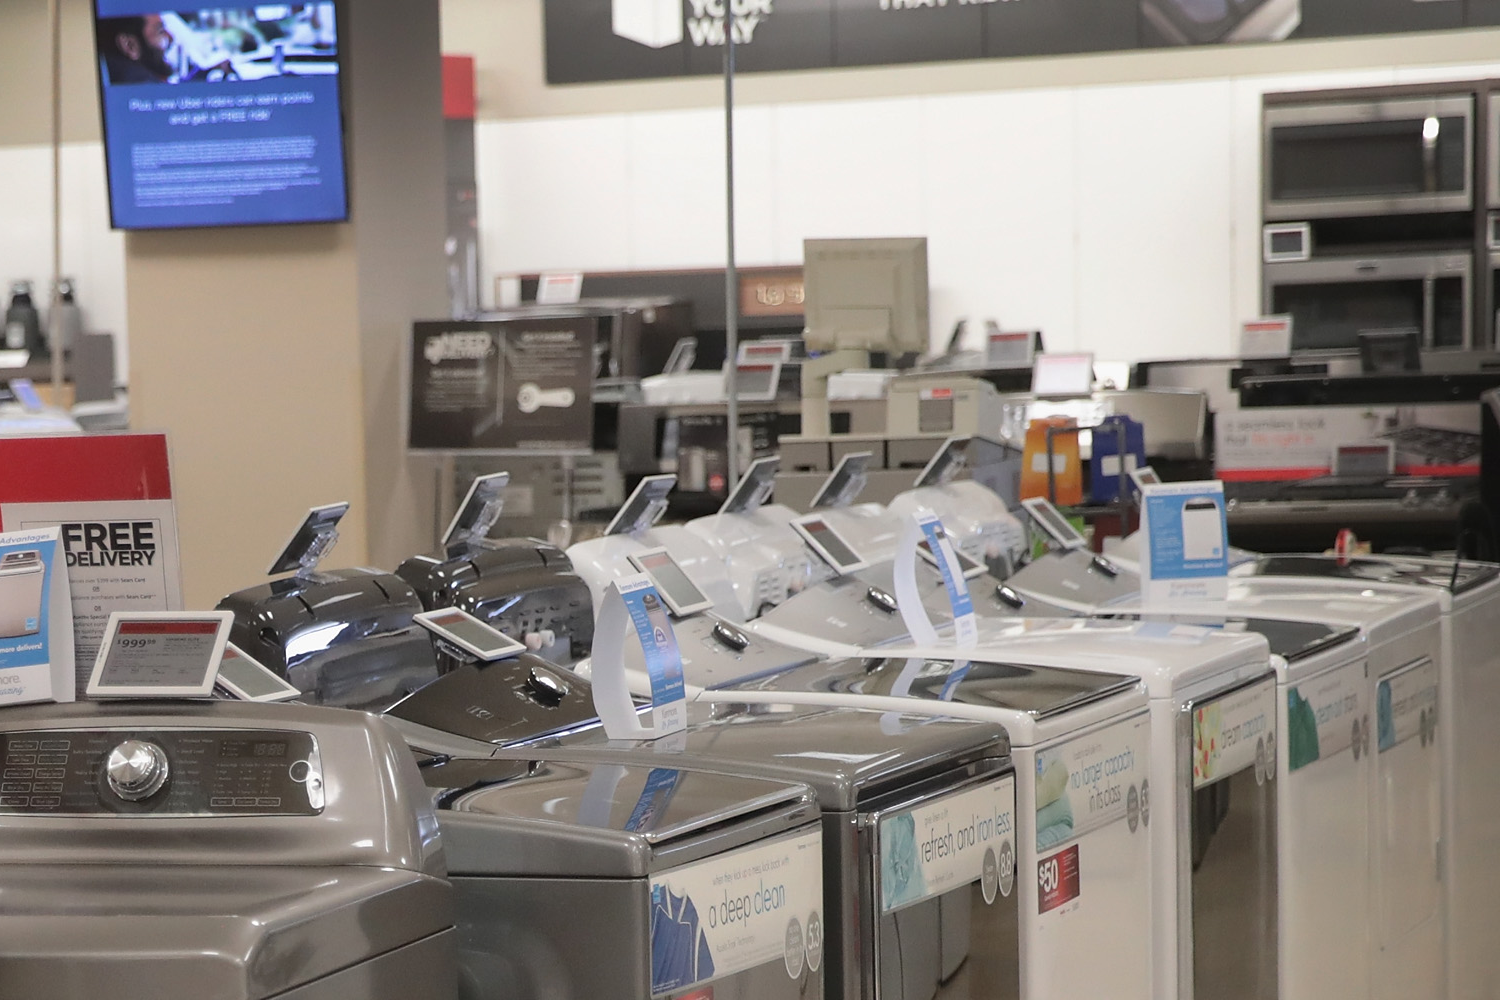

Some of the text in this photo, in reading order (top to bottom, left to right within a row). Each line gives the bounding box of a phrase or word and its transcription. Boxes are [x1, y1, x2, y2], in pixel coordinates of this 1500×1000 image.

[0, 533, 51, 546] Advantages
[61, 522, 156, 551] FREE
[65, 550, 156, 567] DELIVERY
[920, 822, 956, 864] refresh,
[957, 814, 975, 851] and
[976, 815, 993, 843] iron
[1000, 850, 1012, 878] 8.8
[1039, 859, 1059, 893] $50
[709, 879, 786, 929] a deep clean
